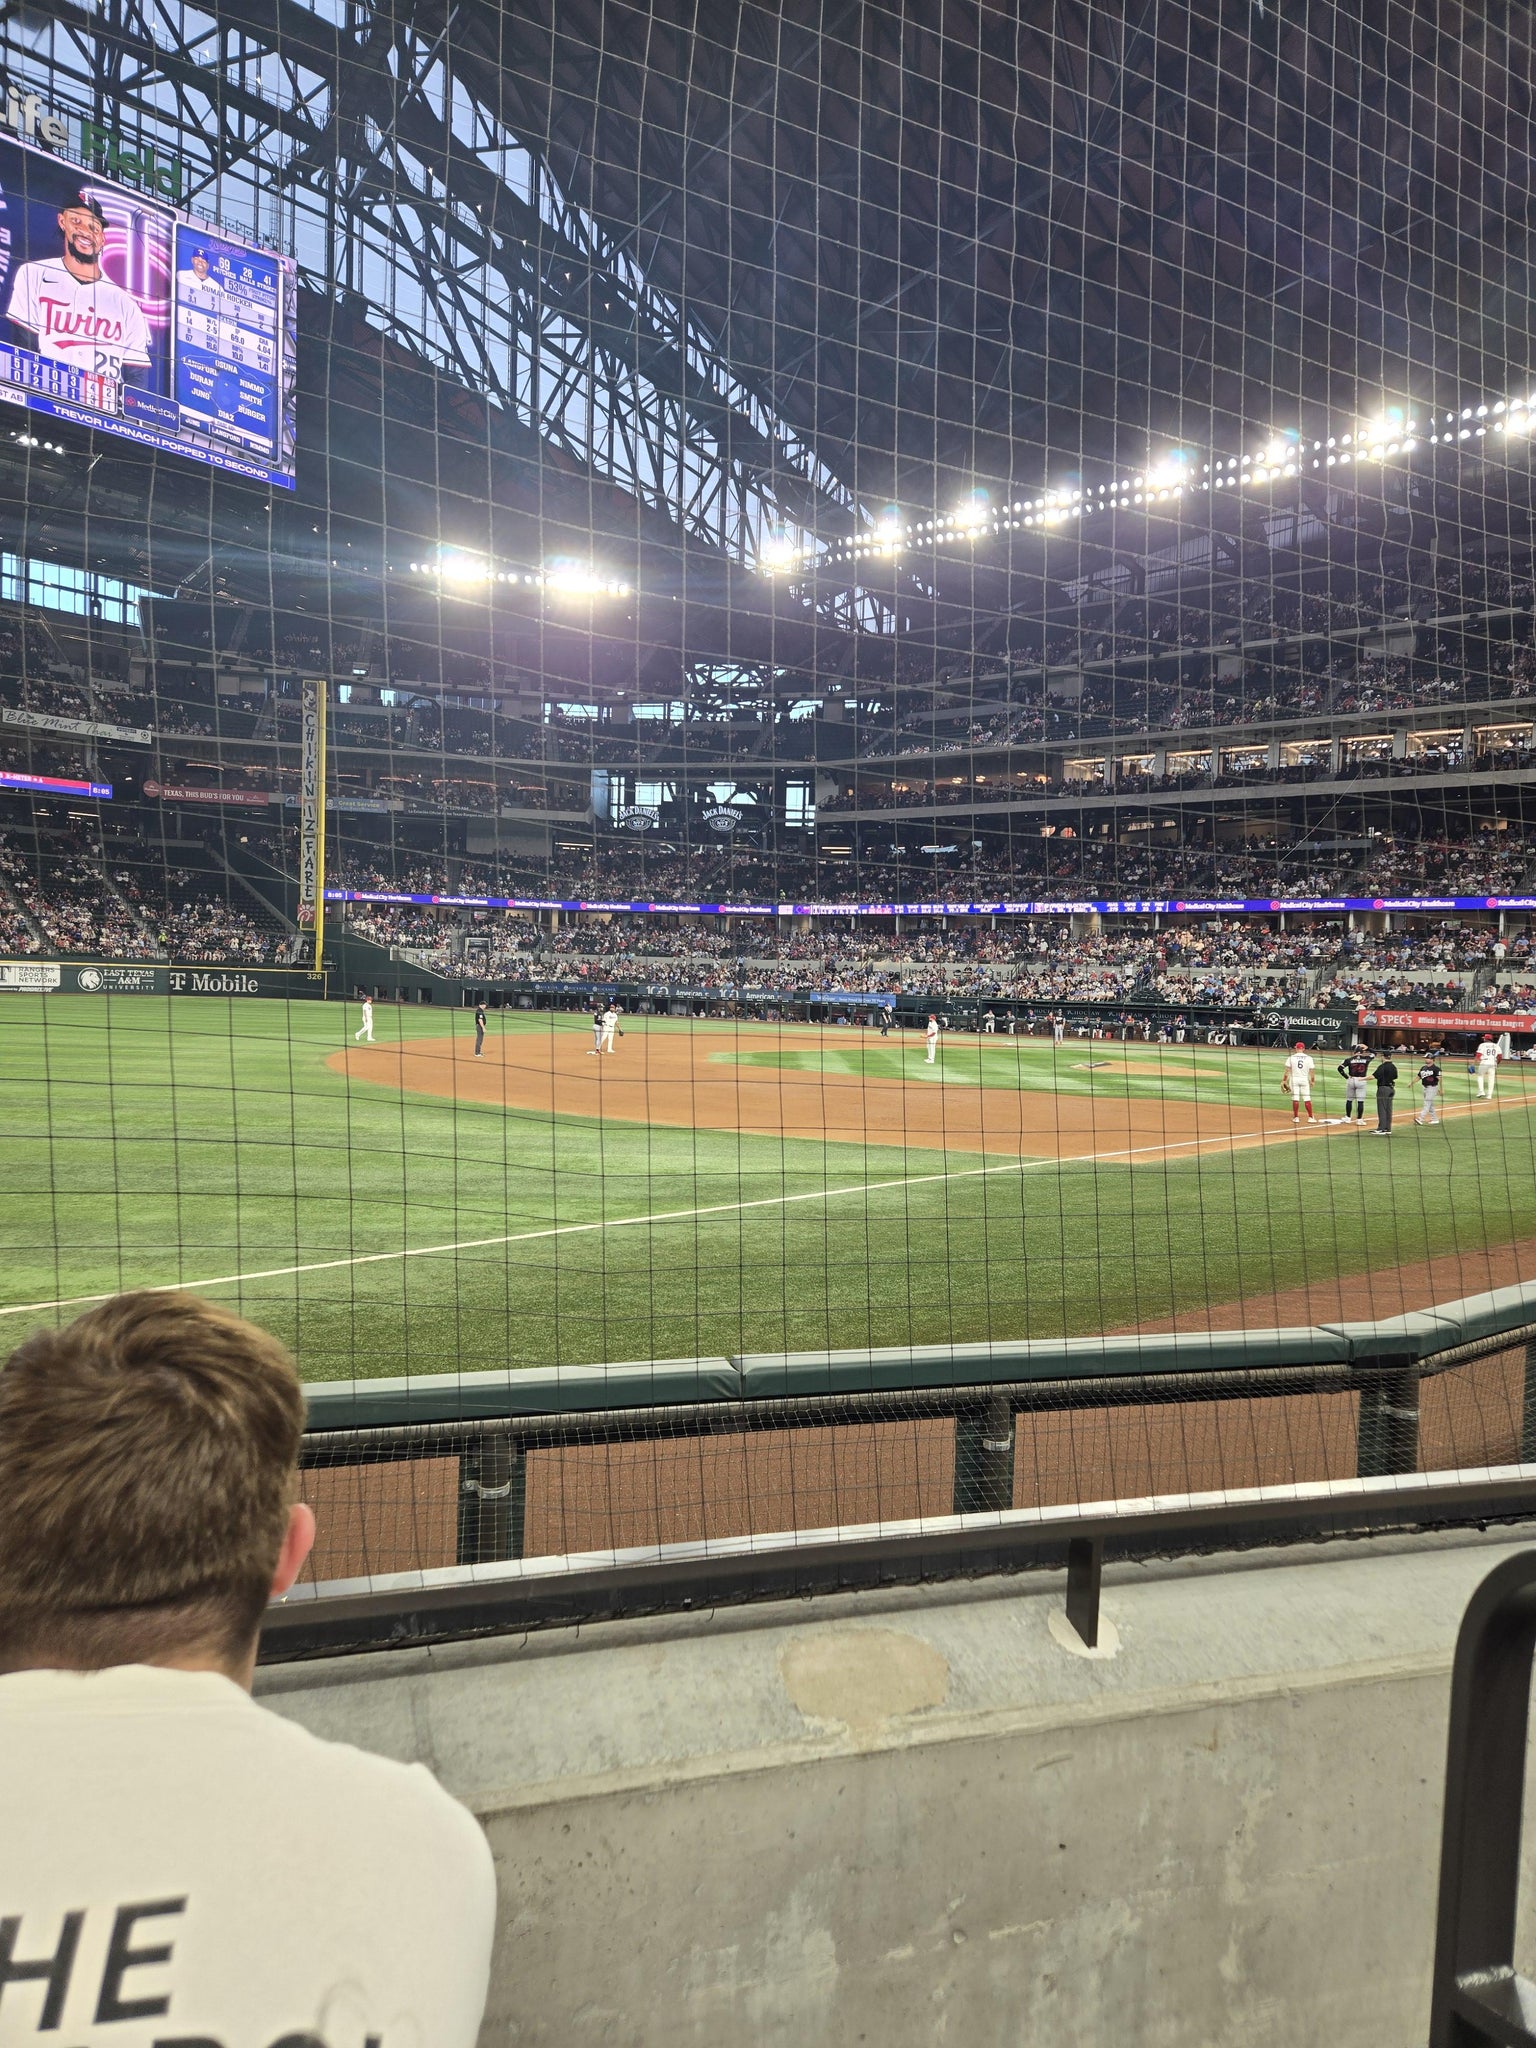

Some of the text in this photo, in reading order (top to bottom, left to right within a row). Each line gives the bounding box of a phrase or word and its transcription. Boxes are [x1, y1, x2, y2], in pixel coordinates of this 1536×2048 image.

[81, 121, 181, 198] Field
[219, 257, 230, 270] 69
[228, 280, 248, 296] 53%
[202, 284, 225, 299] KUMAR
[227, 293, 253, 309] ROCKER
[39, 297, 122, 341] Twins
[95, 350, 121, 379] 25
[215, 359, 238, 374] OSUNA
[33, 363, 39, 372] 7
[53, 369, 58, 380] 0
[70, 376, 76, 386] 3
[107, 388, 111, 397] 2
[33, 377, 39, 386] 2
[190, 371, 214, 387] DURAN
[240, 379, 264, 394] NIMMO
[191, 387, 210, 400] JUNG
[240, 391, 263, 406] SMITH
[218, 409, 235, 422] DIAZ
[238, 404, 266, 422] BURGER
[53, 405, 269, 479] TREVOR LARNACH POPPED TO SECOND
[5, 710, 38, 725] Blue
[40, 717, 80, 732] Mint
[85, 722, 113, 738] Thai
[304, 713, 315, 798] CHIKIN
[164, 789, 184, 798] TEXAS,
[185, 791, 199, 799] THIS
[200, 792, 218, 800] BUD'S
[219, 793, 231, 801] FOR
[304, 809, 316, 832] IZ
[619, 807, 634, 820] JACK
[702, 806, 743, 820] JACK DANIEL'S
[304, 840, 314, 899] FARE
[104, 969, 155, 978] EAST TEXAS
[118, 976, 141, 985] A&M
[192, 973, 259, 993] Mobile
[1321, 1017, 1342, 1029] City
[1380, 1014, 1413, 1025] SPEC'S
[1418, 1016, 1435, 1024] Official
[1437, 1017, 1453, 1025] Liquor
[1503, 1020, 1525, 1028] Rangers
[1298, 1060, 1304, 1069] 6
[0, 1893, 189, 2032] HE
